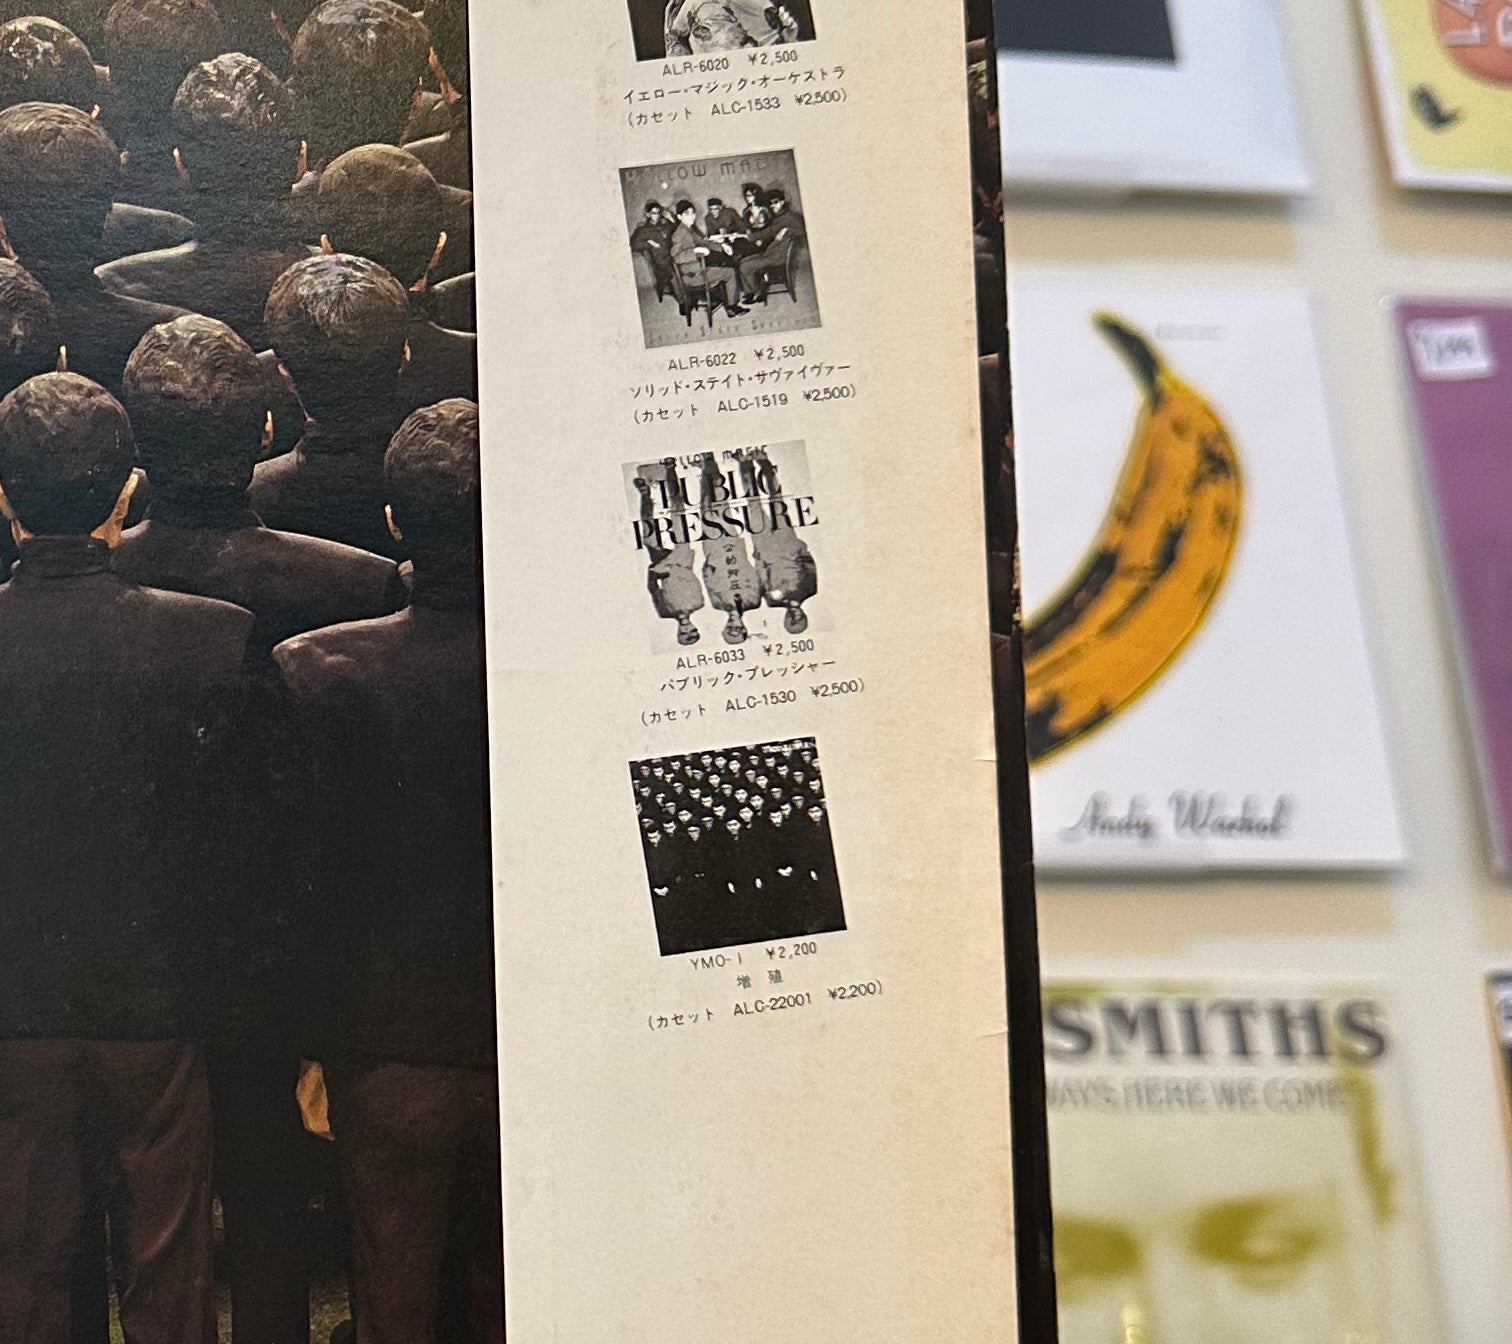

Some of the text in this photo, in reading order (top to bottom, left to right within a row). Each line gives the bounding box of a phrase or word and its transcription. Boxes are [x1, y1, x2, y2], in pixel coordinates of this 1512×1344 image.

[662, 49, 799, 77] ALR-6020 ¥2,500
[710, 96, 781, 118] ALC-1533
[794, 88, 849, 108] ¥2,500)
[667, 342, 806, 372] ALR-6022 ¥2,500
[717, 391, 789, 413] ALC-1519
[802, 382, 857, 402] ¥2,500)
[632, 495, 820, 551] PRESSURE
[675, 638, 815, 670] ALR-6033 ¥2,500
[725, 689, 797, 713] ALC-1530
[809, 677, 865, 699] ¥2,500)
[1168, 788, 1294, 837] Warhol
[764, 940, 818, 961] ¥2,200
[733, 991, 812, 1017] ALC-22001
[826, 978, 885, 1002] ¥2,200)
[1044, 998, 1387, 1064] SMITHS
